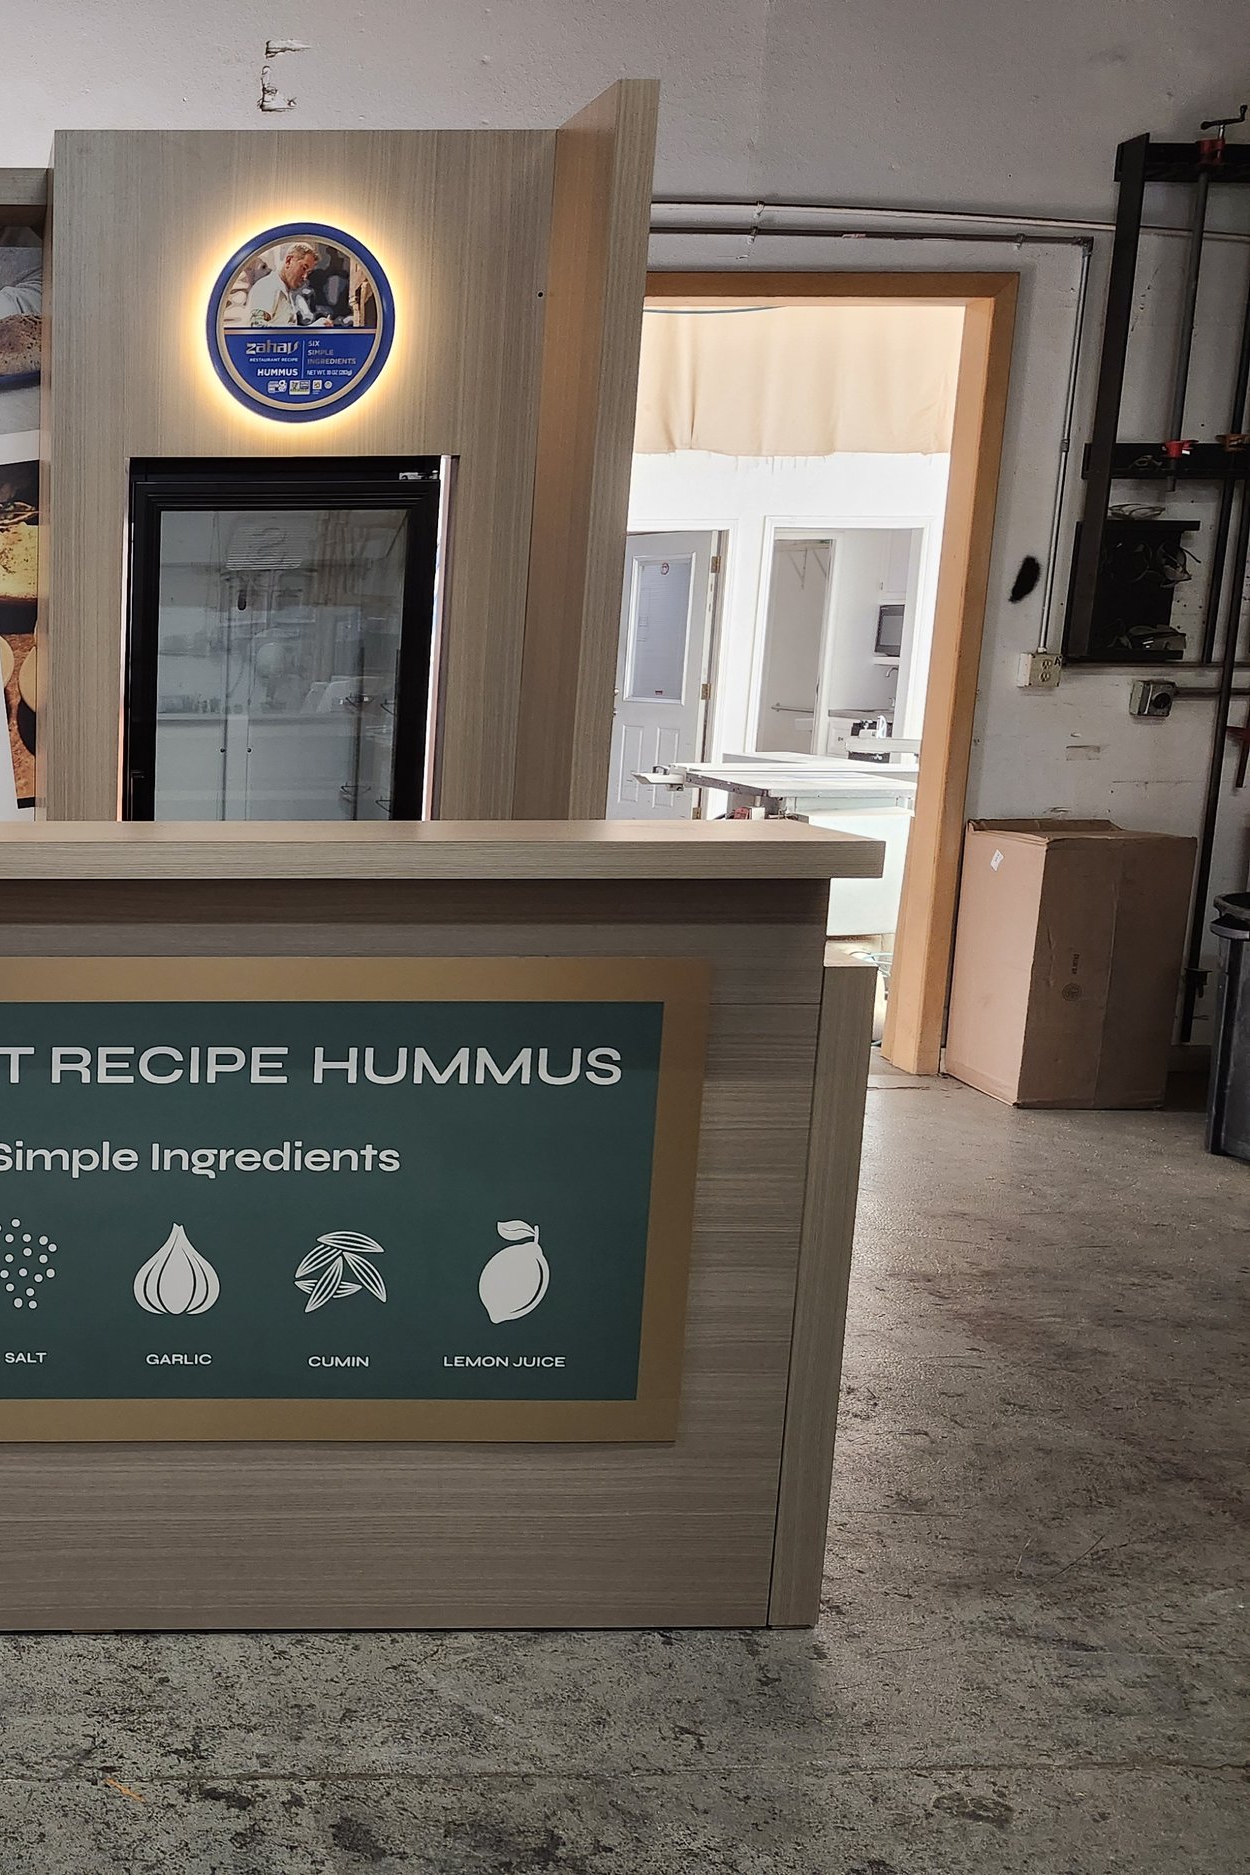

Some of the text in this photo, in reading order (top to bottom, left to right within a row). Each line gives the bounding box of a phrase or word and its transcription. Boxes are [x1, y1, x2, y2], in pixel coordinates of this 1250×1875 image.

[257, 368, 298, 376] HUMMUS
[52, 1047, 288, 1083] RECIPE
[314, 1047, 621, 1085] HUMMUS
[152, 1141, 399, 1178] Ingredients
[5, 1353, 46, 1363] SALT
[147, 1354, 211, 1364] GARLIC
[309, 1357, 368, 1366] CUMIN
[444, 1357, 565, 1367] LEMON JUICE
